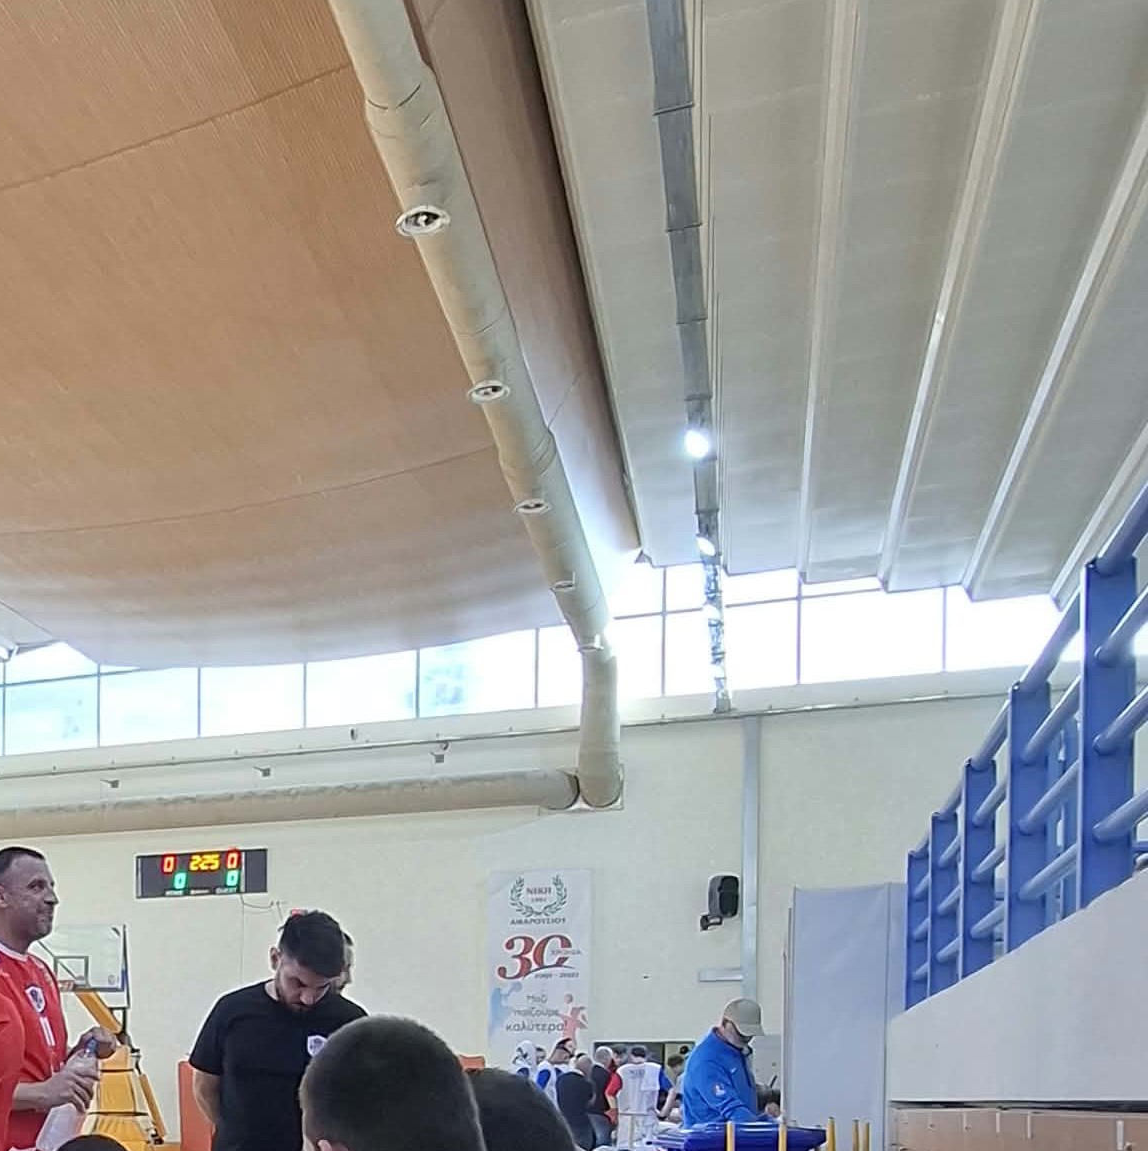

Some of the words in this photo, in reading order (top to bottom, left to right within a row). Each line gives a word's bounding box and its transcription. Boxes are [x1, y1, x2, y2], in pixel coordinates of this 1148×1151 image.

[163, 856, 175, 873] 0
[227, 851, 238, 869] 0
[174, 872, 186, 889] 0
[226, 869, 239, 887] 0
